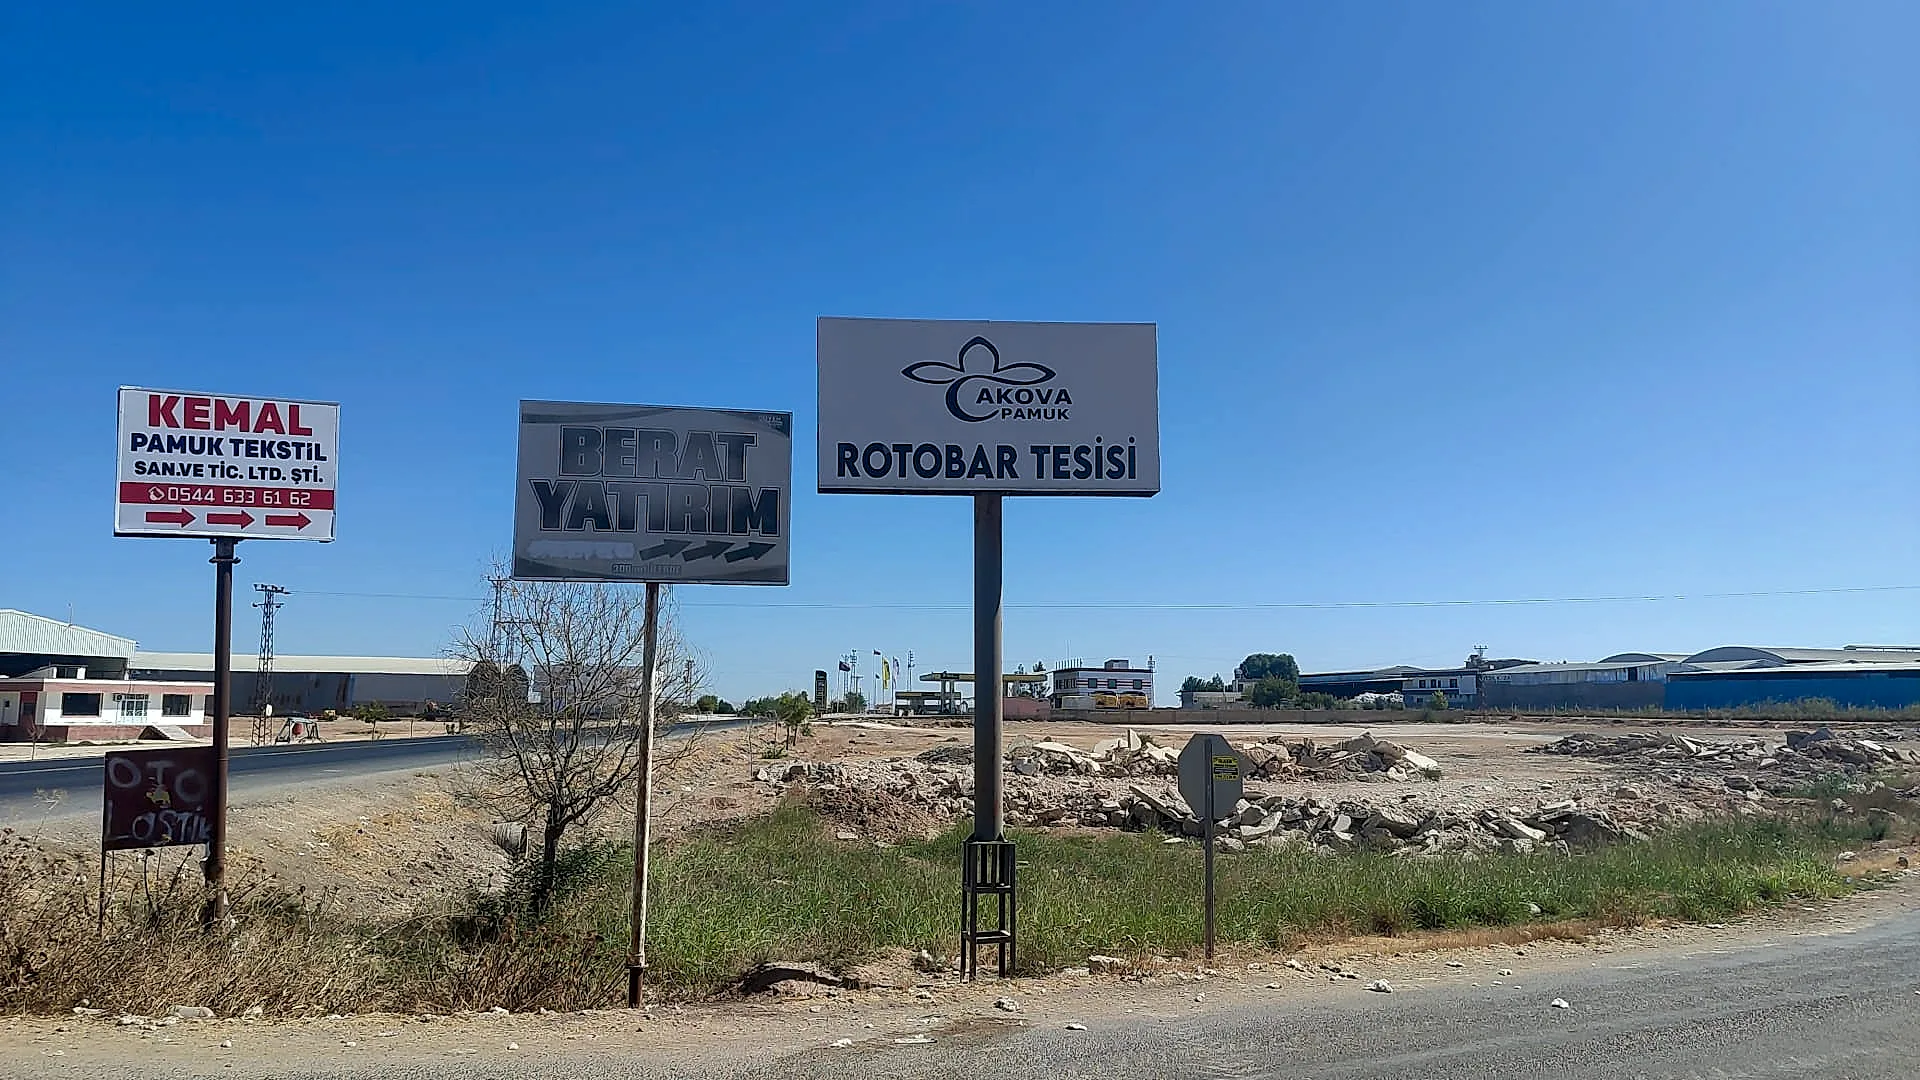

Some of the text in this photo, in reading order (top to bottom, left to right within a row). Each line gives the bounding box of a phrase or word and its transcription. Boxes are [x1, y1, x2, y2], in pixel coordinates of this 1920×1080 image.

[975, 387, 1073, 405] AKOVA
[148, 394, 313, 437] KEMAL
[1001, 408, 1070, 420] PAMUK
[130, 432, 224, 456] PAMUK
[559, 425, 758, 483] BERAT
[837, 435, 1137, 480] ROTOBAR TESİSİ
[207, 460, 244, 480] TİC.
[249, 466, 287, 482] LTD.
[291, 465, 324, 485] ŞTİ.
[167, 486, 311, 506] 0544 633 61 62
[528, 479, 781, 537] YATIRIM
[108, 757, 209, 802] OTO
